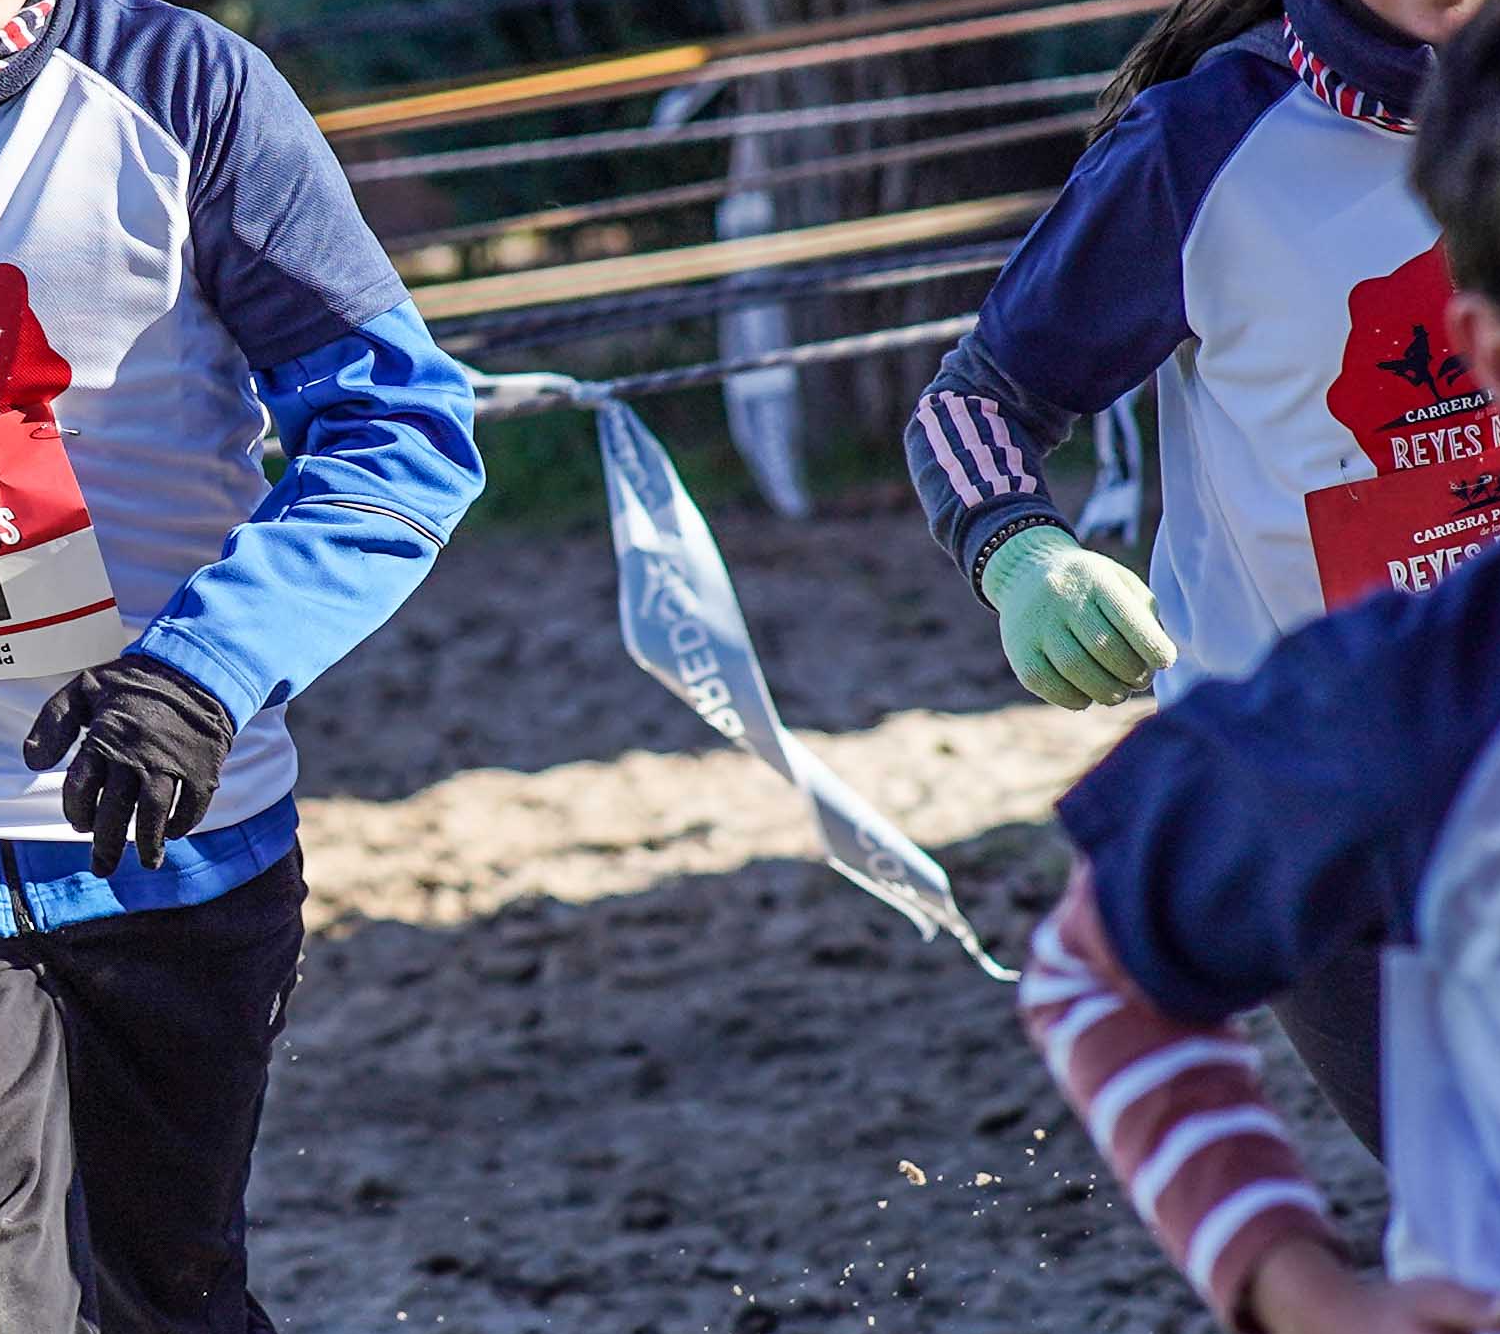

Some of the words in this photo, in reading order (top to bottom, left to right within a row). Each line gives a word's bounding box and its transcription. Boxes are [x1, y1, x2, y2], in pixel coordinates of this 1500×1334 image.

[1405, 393, 1485, 423] CARRERA
[1390, 424, 1483, 470] REYES
[1413, 513, 1489, 545] CARRERA
